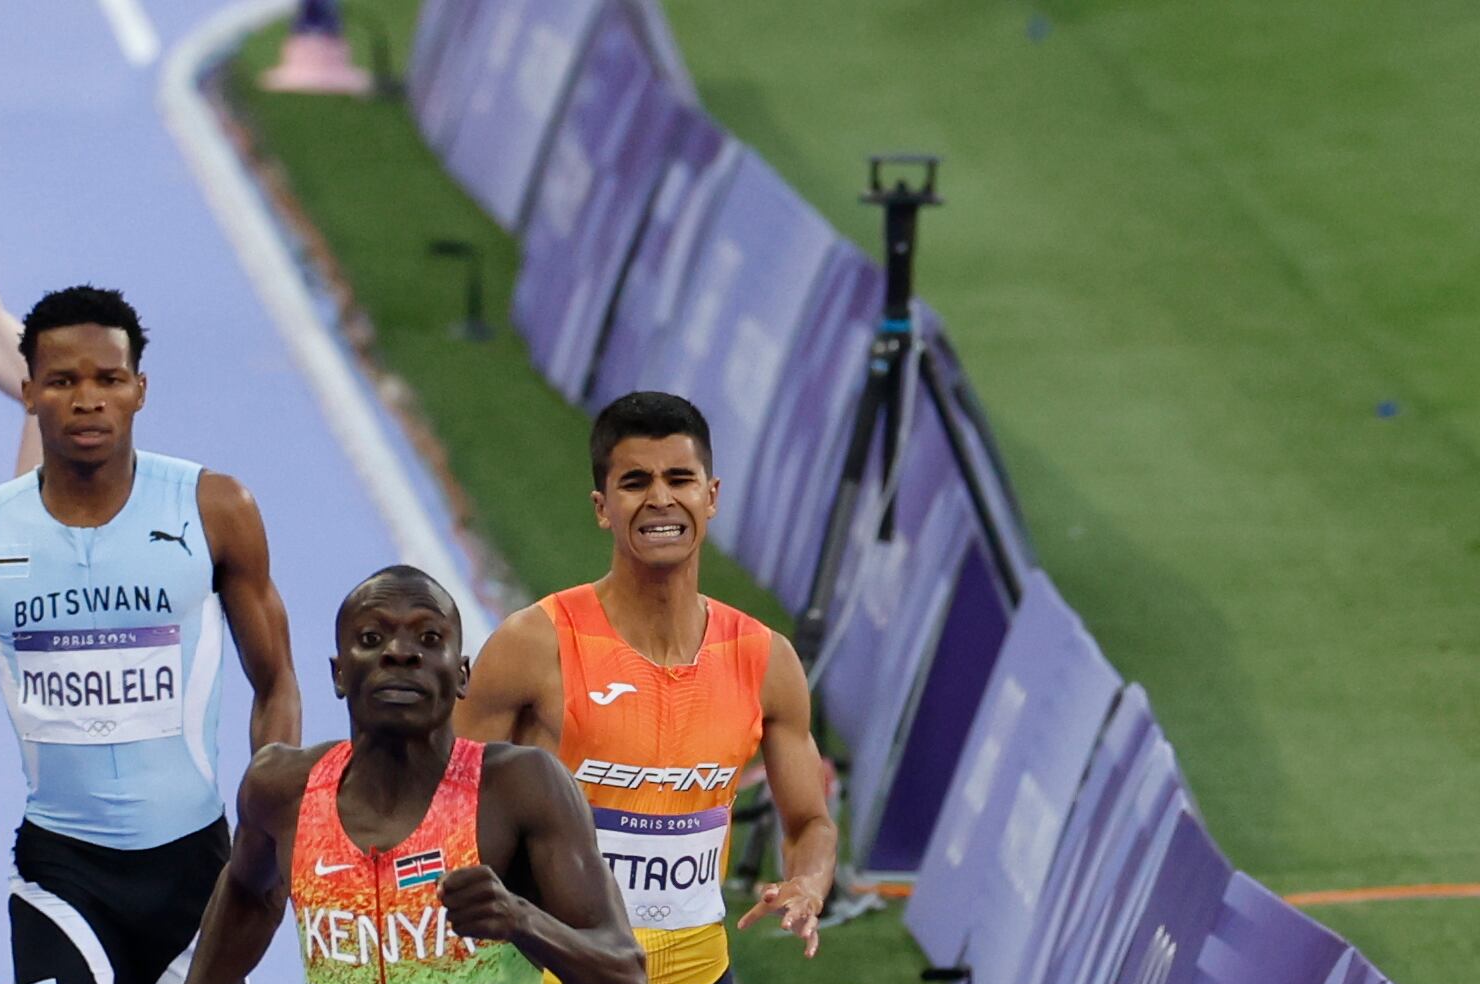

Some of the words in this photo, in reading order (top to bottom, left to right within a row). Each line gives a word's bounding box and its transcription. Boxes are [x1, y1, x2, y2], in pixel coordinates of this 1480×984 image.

[14, 585, 172, 628] BOTSWANA
[52, 635, 94, 646] PARIS
[99, 633, 136, 645] 2024
[22, 666, 174, 707] MASALELA
[574, 759, 737, 791] ESPAÑA
[620, 816, 663, 830] PARIS
[667, 817, 700, 830] 2024
[602, 847, 718, 891] TTAOUI
[303, 905, 476, 965] KENYA
